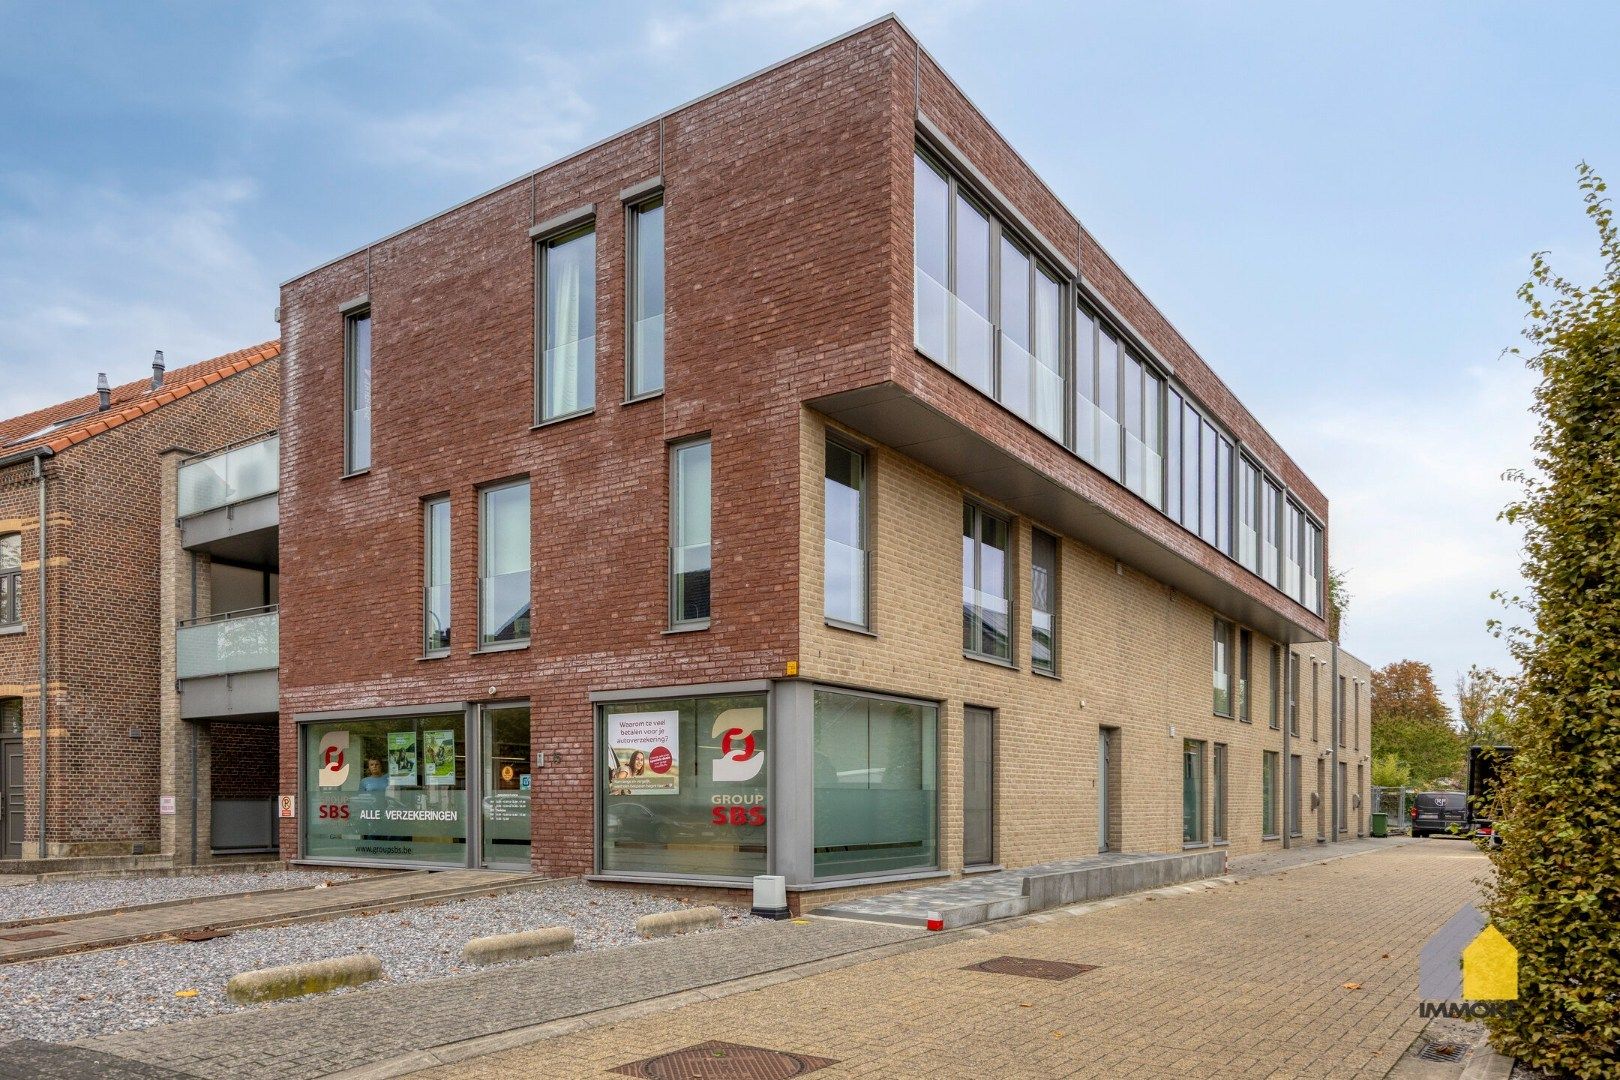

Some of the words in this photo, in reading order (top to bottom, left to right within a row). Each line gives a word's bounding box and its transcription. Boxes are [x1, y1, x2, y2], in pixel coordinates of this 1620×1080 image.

[620, 728, 643, 736] betalen
[616, 735, 669, 744] autoverzekering?
[711, 794, 764, 805] GROUP
[319, 804, 350, 819] SBS
[360, 809, 381, 820] ALLE
[385, 810, 458, 822] VERZEKERINGEN
[711, 806, 766, 827] SBS
[354, 845, 413, 856] www.groupsbs.be
